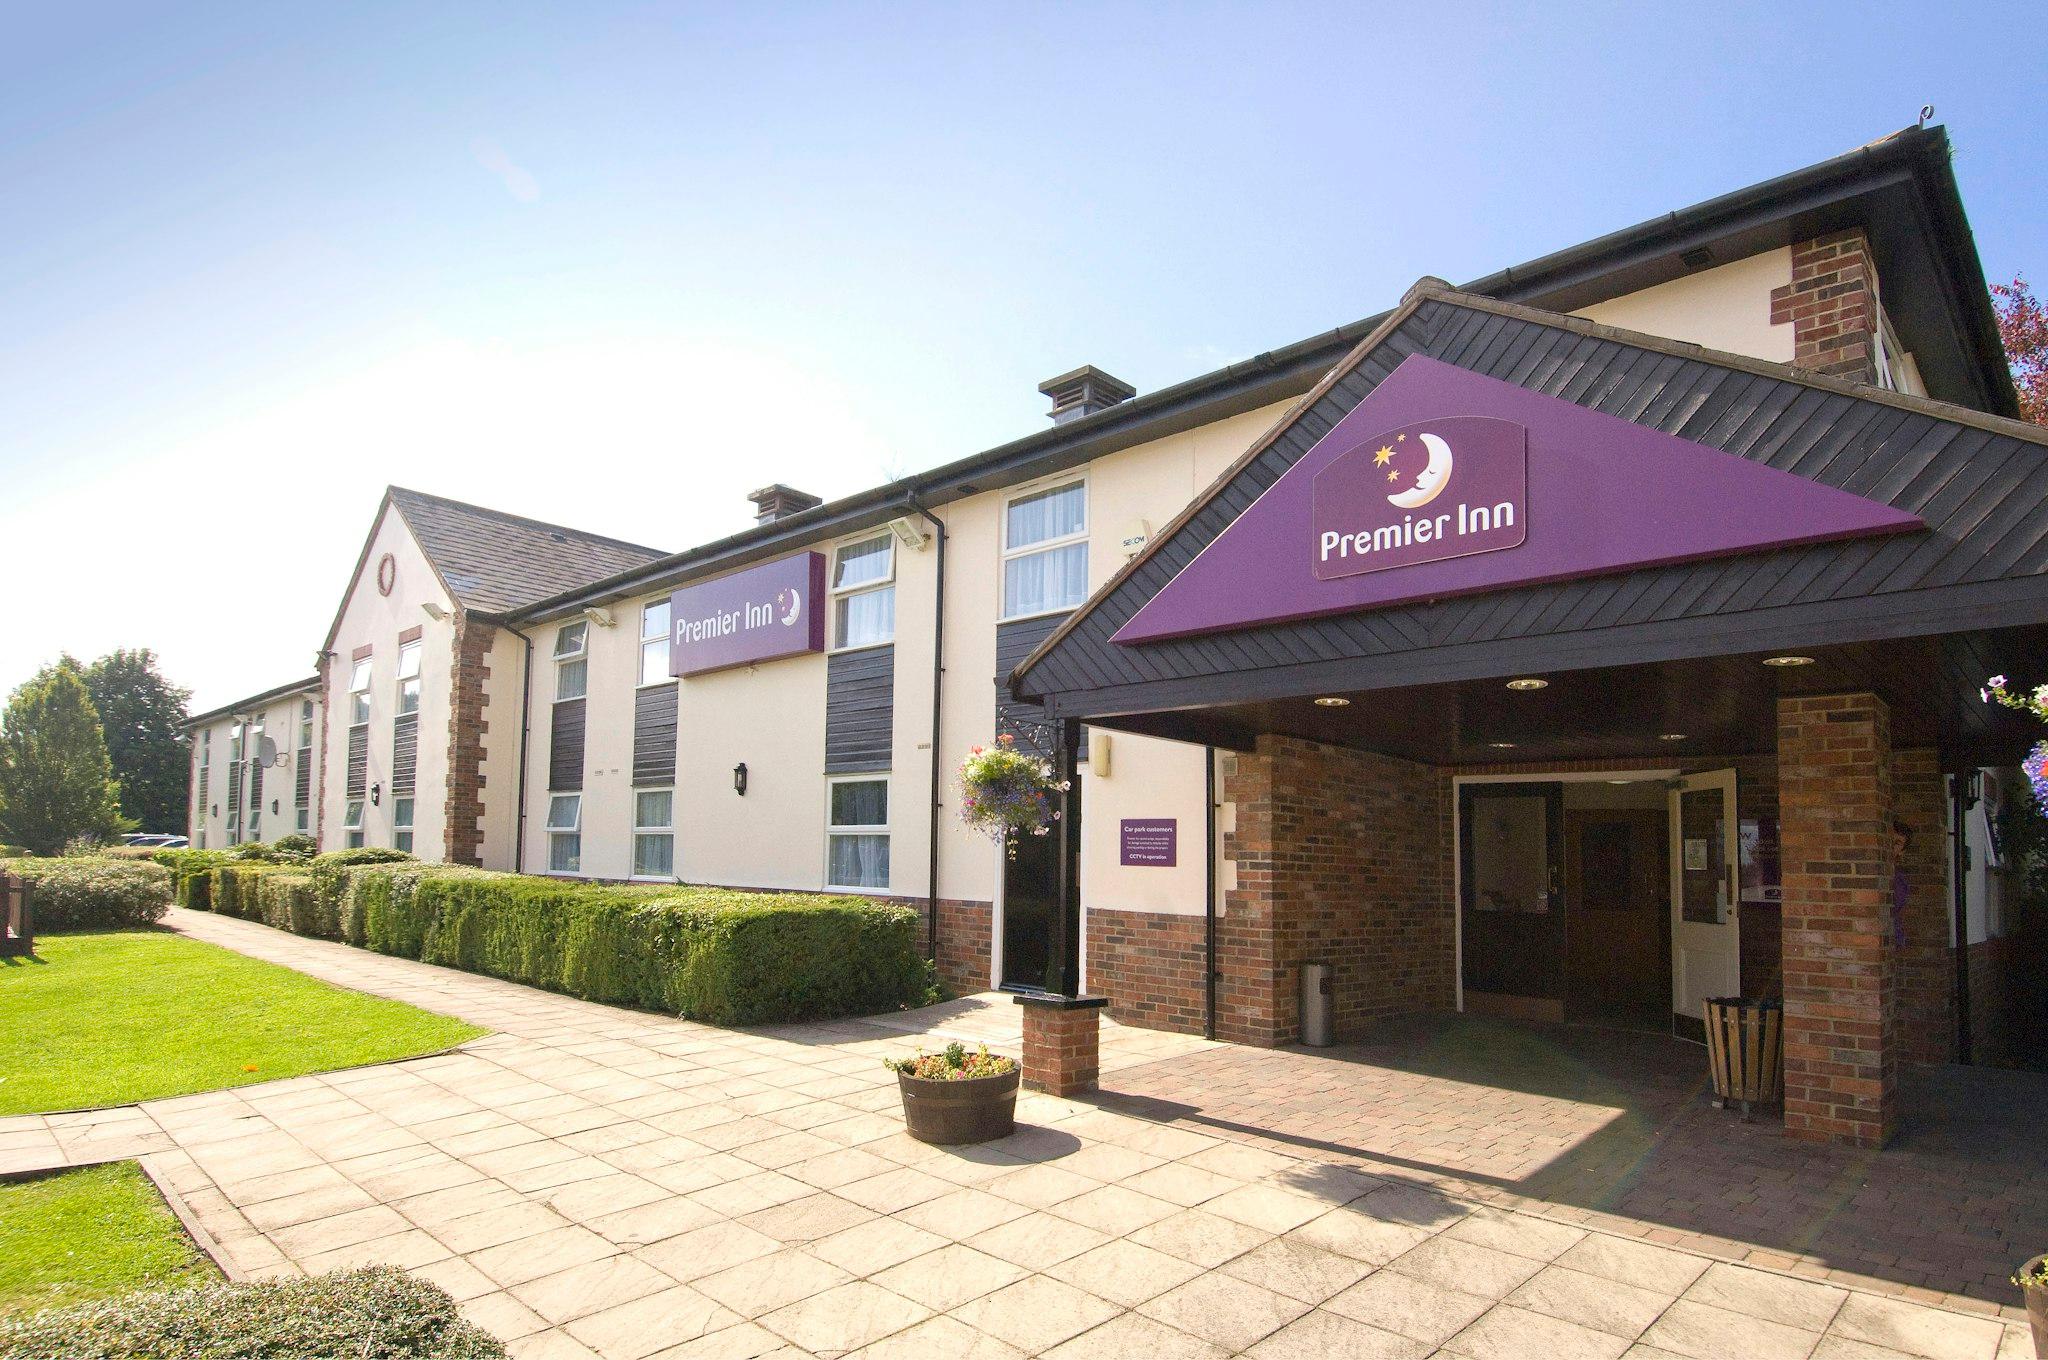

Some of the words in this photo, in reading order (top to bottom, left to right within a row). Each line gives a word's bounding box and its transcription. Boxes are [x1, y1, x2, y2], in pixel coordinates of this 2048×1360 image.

[1123, 536, 1145, 546] SECOM
[1321, 514, 1451, 561] Premier
[1458, 501, 1514, 535] Inn
[676, 610, 740, 645] Premier
[745, 602, 773, 630] Inn
